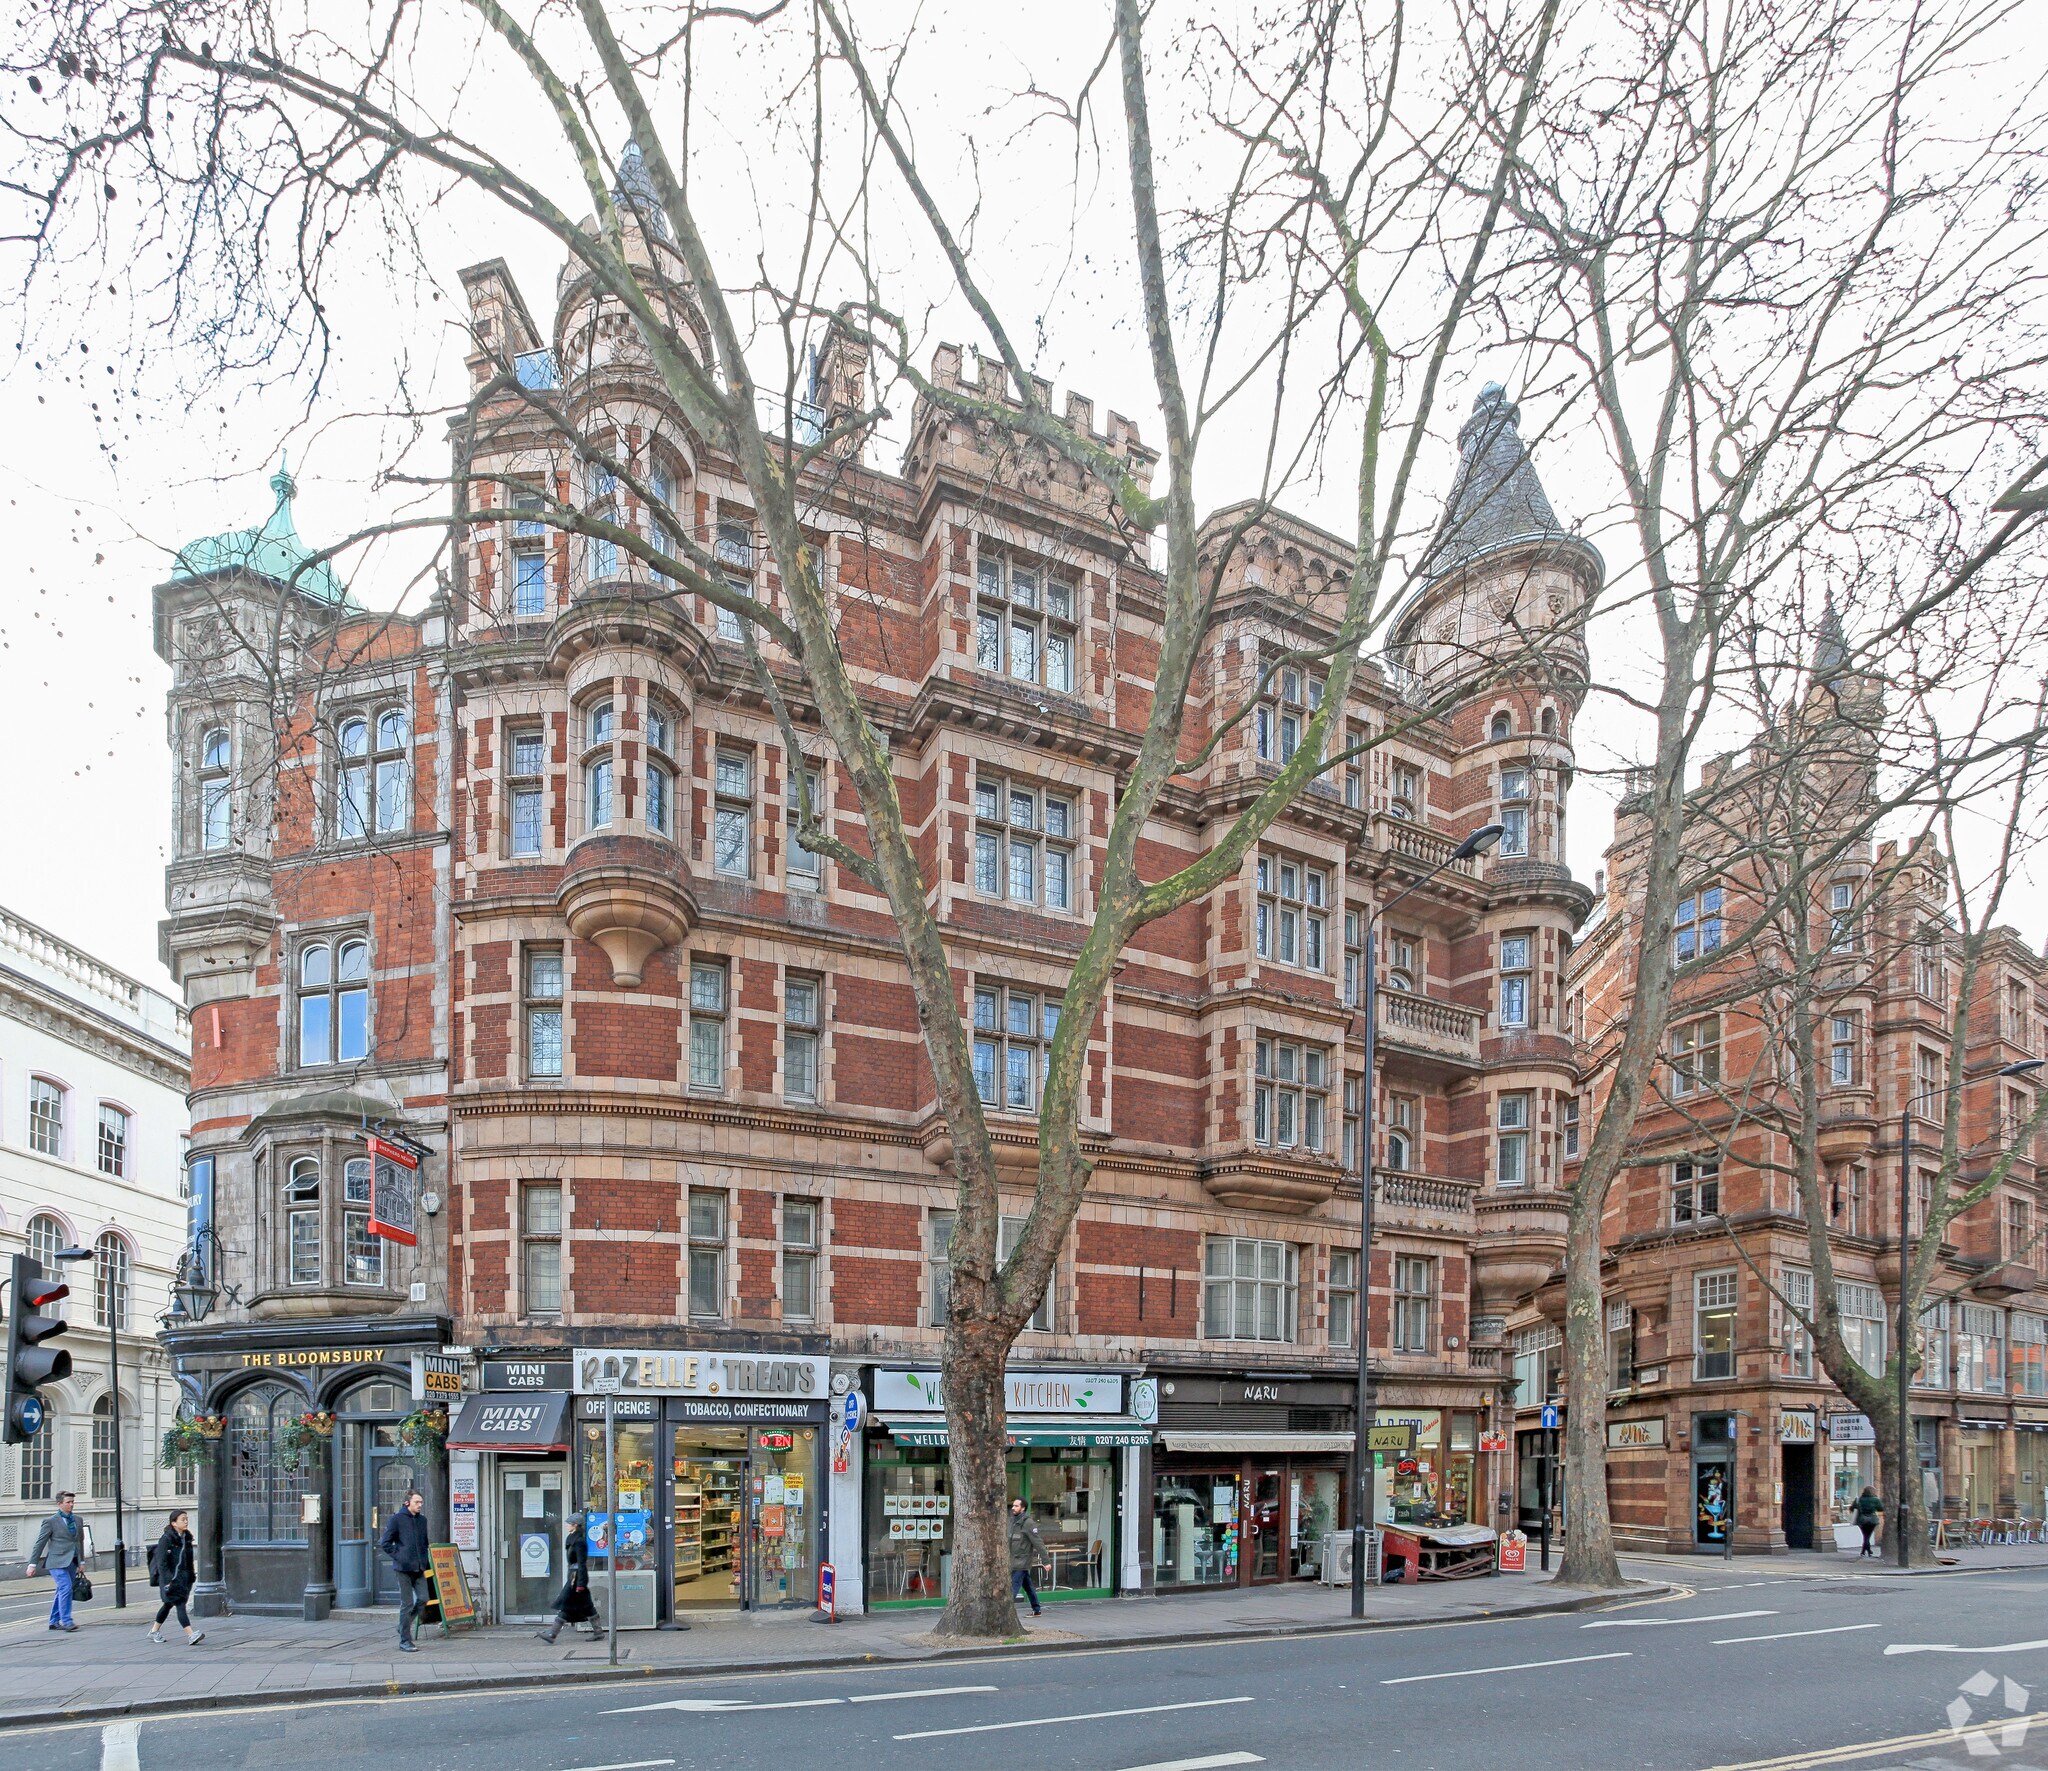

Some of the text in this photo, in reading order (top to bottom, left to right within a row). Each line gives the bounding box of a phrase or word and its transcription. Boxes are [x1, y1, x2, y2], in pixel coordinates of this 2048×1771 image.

[242, 1349, 384, 1367] THE BLOOMSBURY
[426, 1357, 458, 1375] MINI
[506, 1365, 546, 1375] MINI
[426, 1374, 459, 1390] CABS
[508, 1377, 544, 1386] CABS
[1014, 1381, 1071, 1408] KITCHEN
[1244, 1385, 1278, 1401] NARU
[482, 1407, 541, 1420] MINI
[586, 1401, 651, 1415] OFF ICENCE
[684, 1403, 809, 1418] TOBACCO, CONFECTIONARY
[480, 1420, 533, 1431] CABS
[1095, 1436, 1149, 1445] 0207 240 6205
[1374, 1436, 1403, 1446] NARU
[1243, 1479, 1251, 1509] NARU
